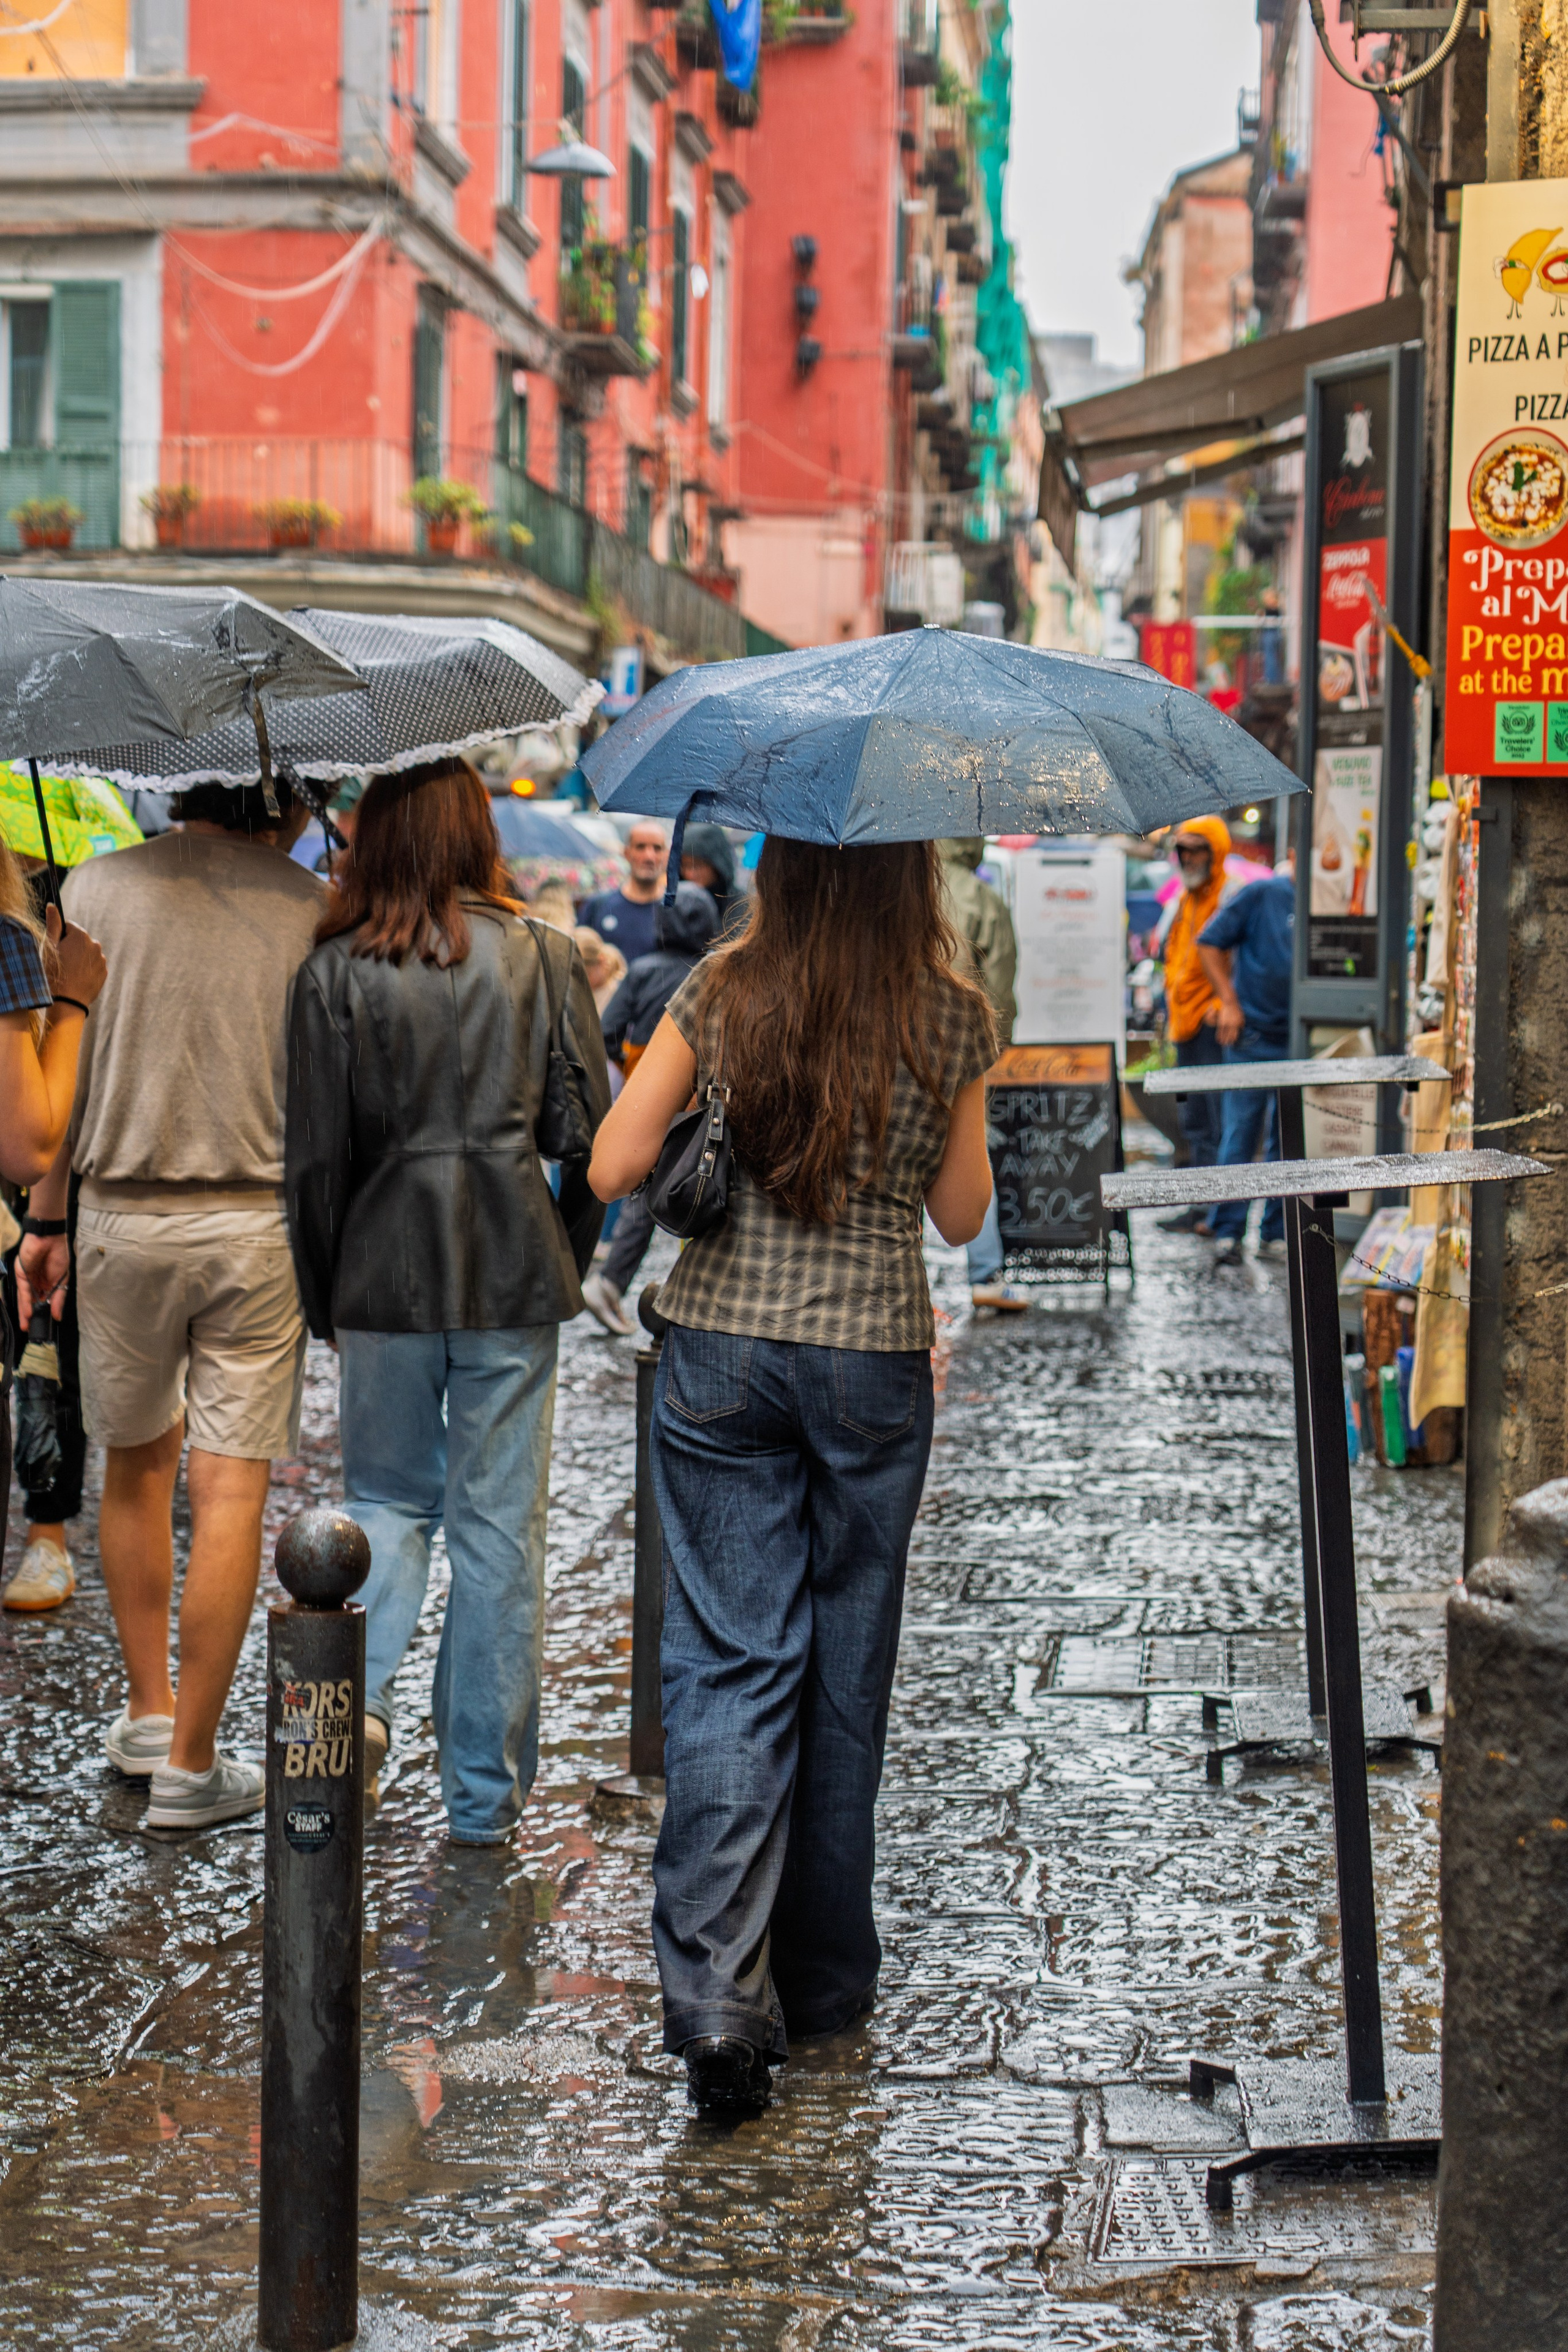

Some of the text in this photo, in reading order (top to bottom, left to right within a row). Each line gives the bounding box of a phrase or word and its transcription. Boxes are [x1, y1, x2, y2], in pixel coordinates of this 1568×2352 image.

[1469, 334, 1530, 363] PIZZA
[1536, 332, 1551, 360] A
[1463, 545, 1568, 592] Prep
[1481, 585, 1512, 617] al
[1459, 669, 1485, 695] at
[1491, 666, 1532, 695] the
[990, 1090, 1093, 1126] SPRITZ
[1016, 1126, 1068, 1156] TAKE
[998, 1151, 1080, 1180] AWAY
[322, 1718, 350, 1739] CREW
[284, 1738, 350, 1779] BRU
[295, 1822, 322, 1832] STAFF
